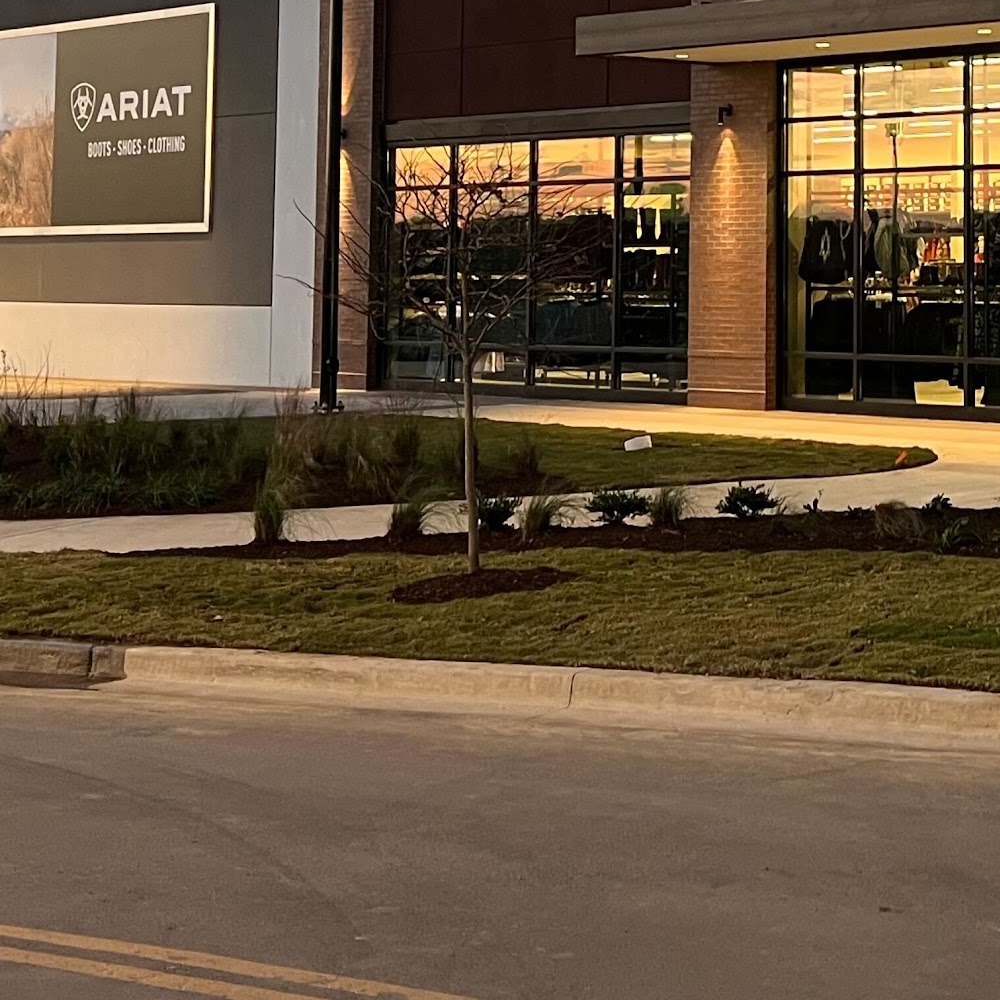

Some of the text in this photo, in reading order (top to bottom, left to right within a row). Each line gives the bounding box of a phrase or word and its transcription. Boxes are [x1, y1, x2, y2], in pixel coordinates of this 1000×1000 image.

[96, 85, 191, 123] ARIAT
[87, 135, 186, 158] BOOTS SHOES CLOTHING
